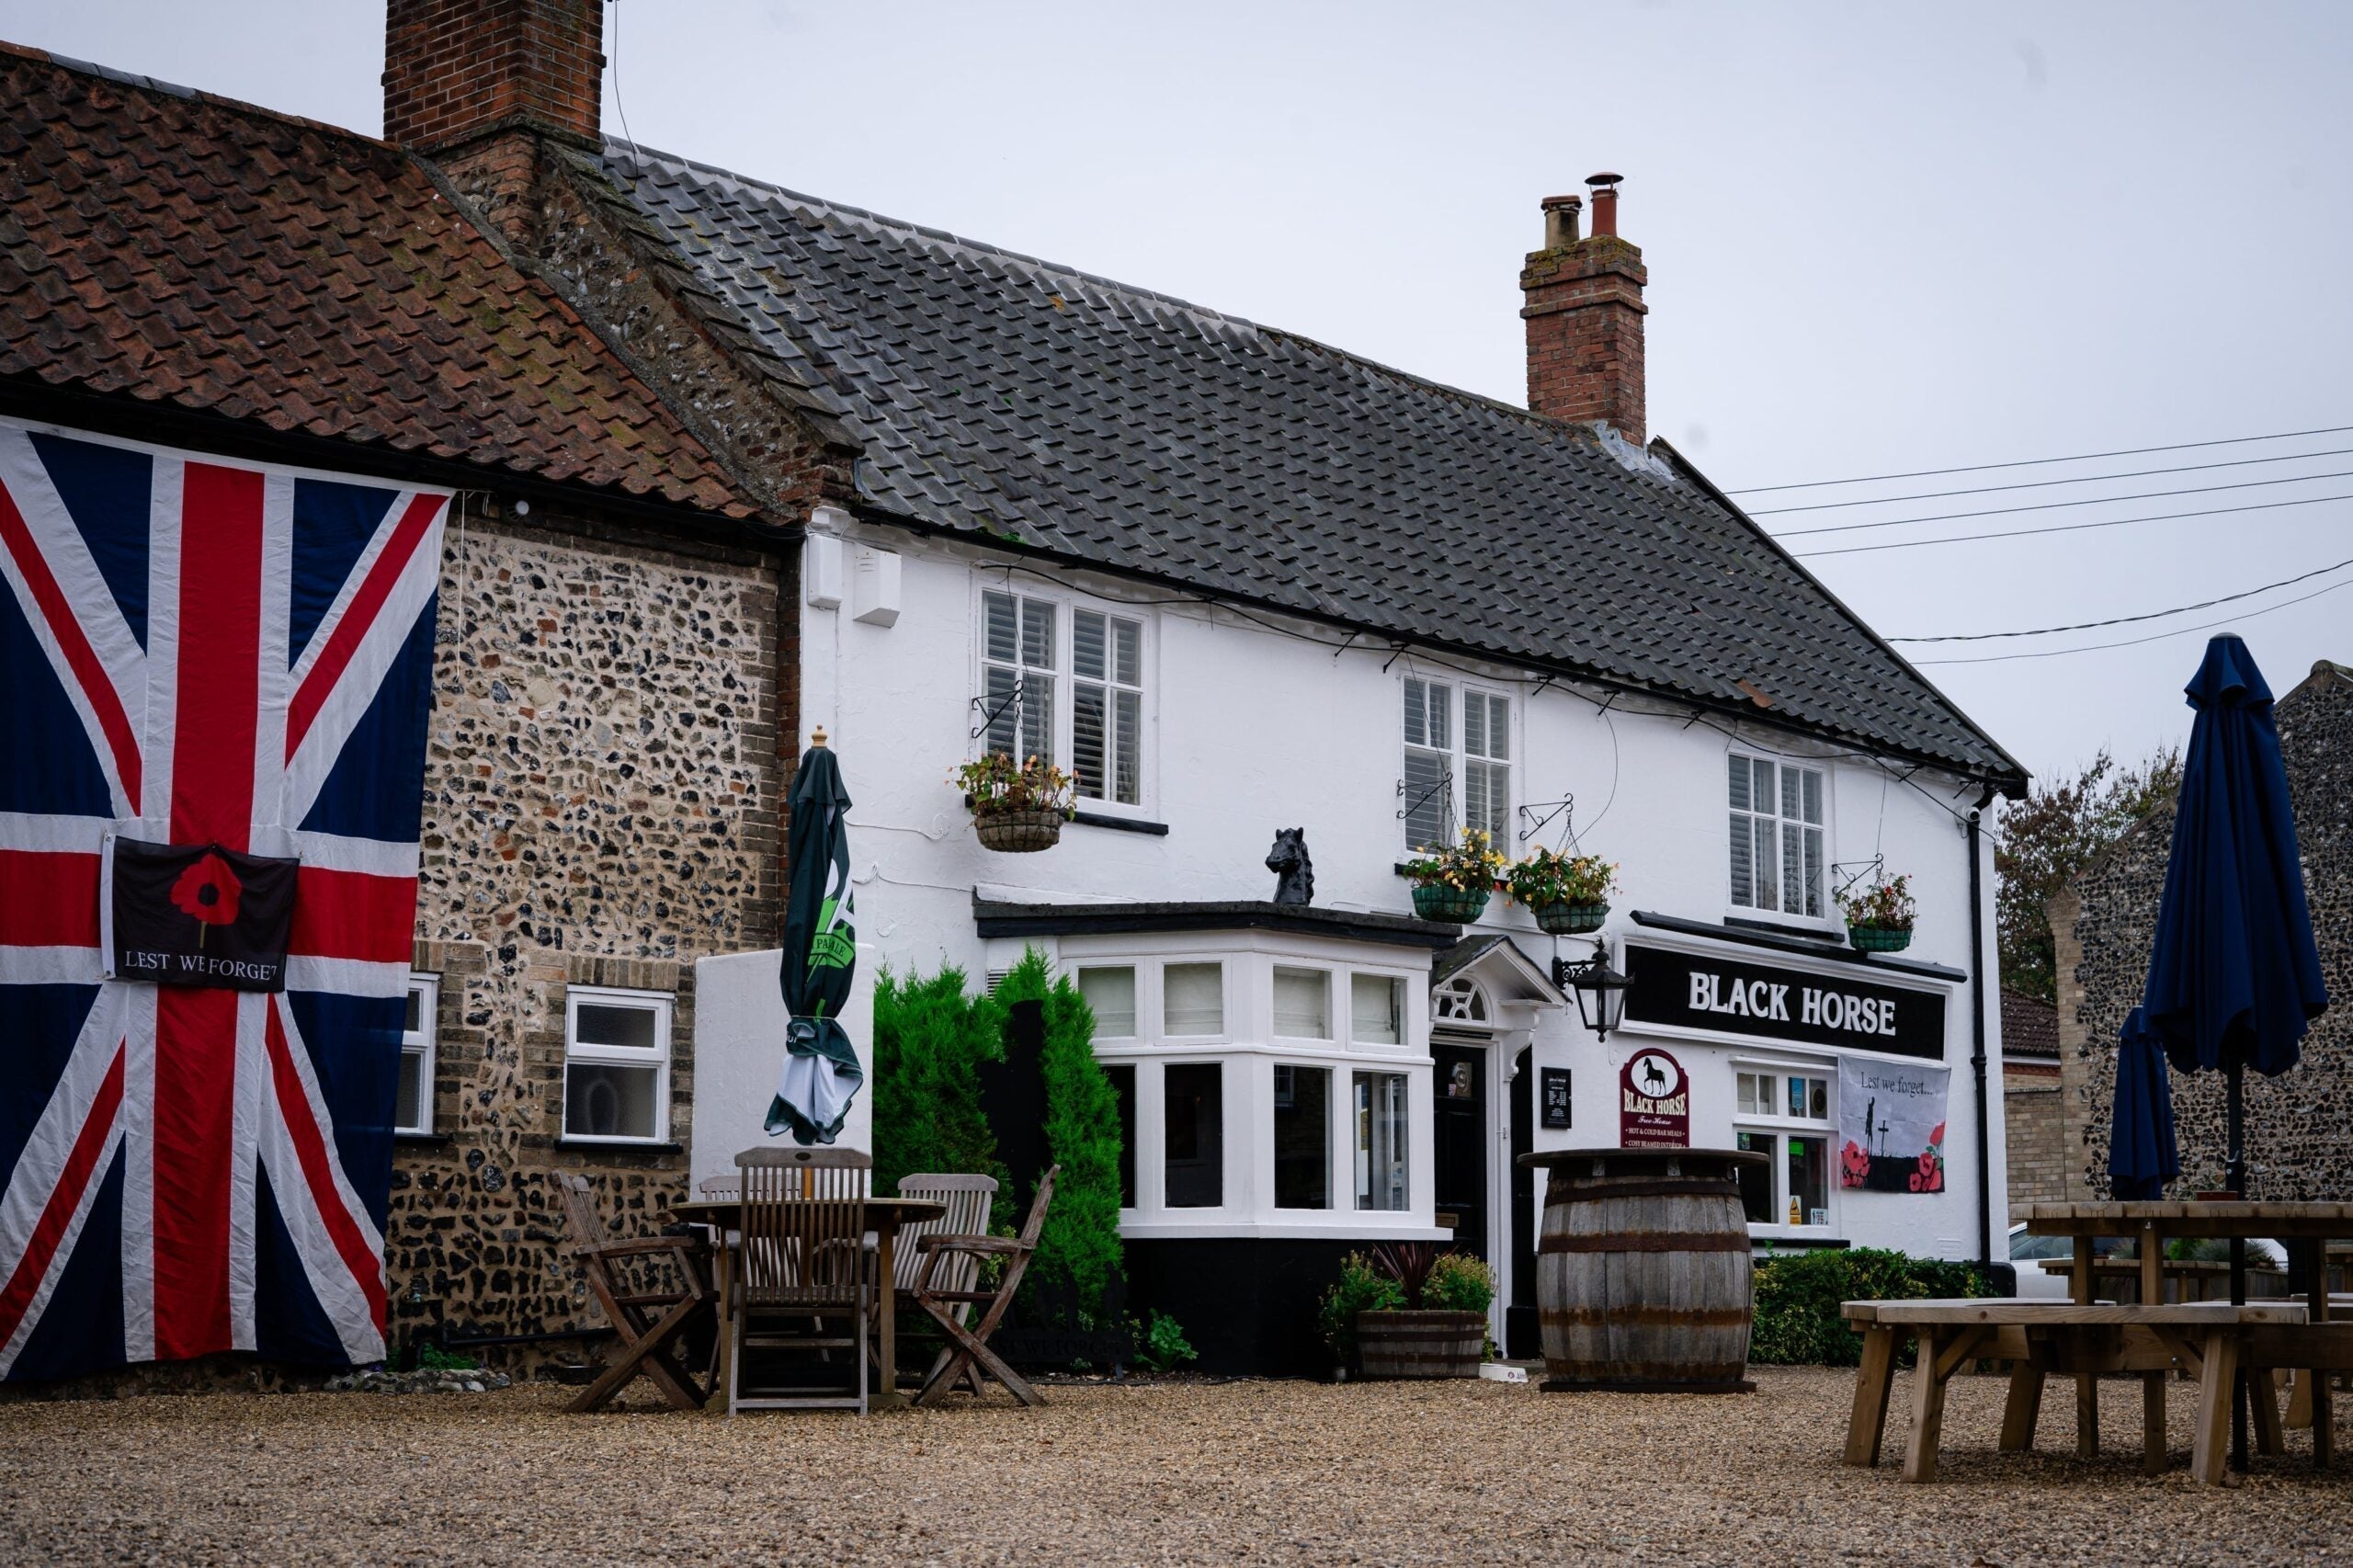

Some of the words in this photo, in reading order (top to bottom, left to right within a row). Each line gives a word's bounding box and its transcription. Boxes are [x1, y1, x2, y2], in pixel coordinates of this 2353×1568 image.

[125, 950, 170, 970] LEST
[179, 955, 205, 972] WE
[1688, 971, 1790, 1022] BLACK
[1801, 987, 1896, 1037] HORSE
[1861, 1072, 1880, 1089] Lest
[1881, 1080, 1895, 1092] we
[1624, 1089, 1654, 1115] BLACK
[1656, 1093, 1686, 1116] HORSE
[1652, 1117, 1672, 1125] House
